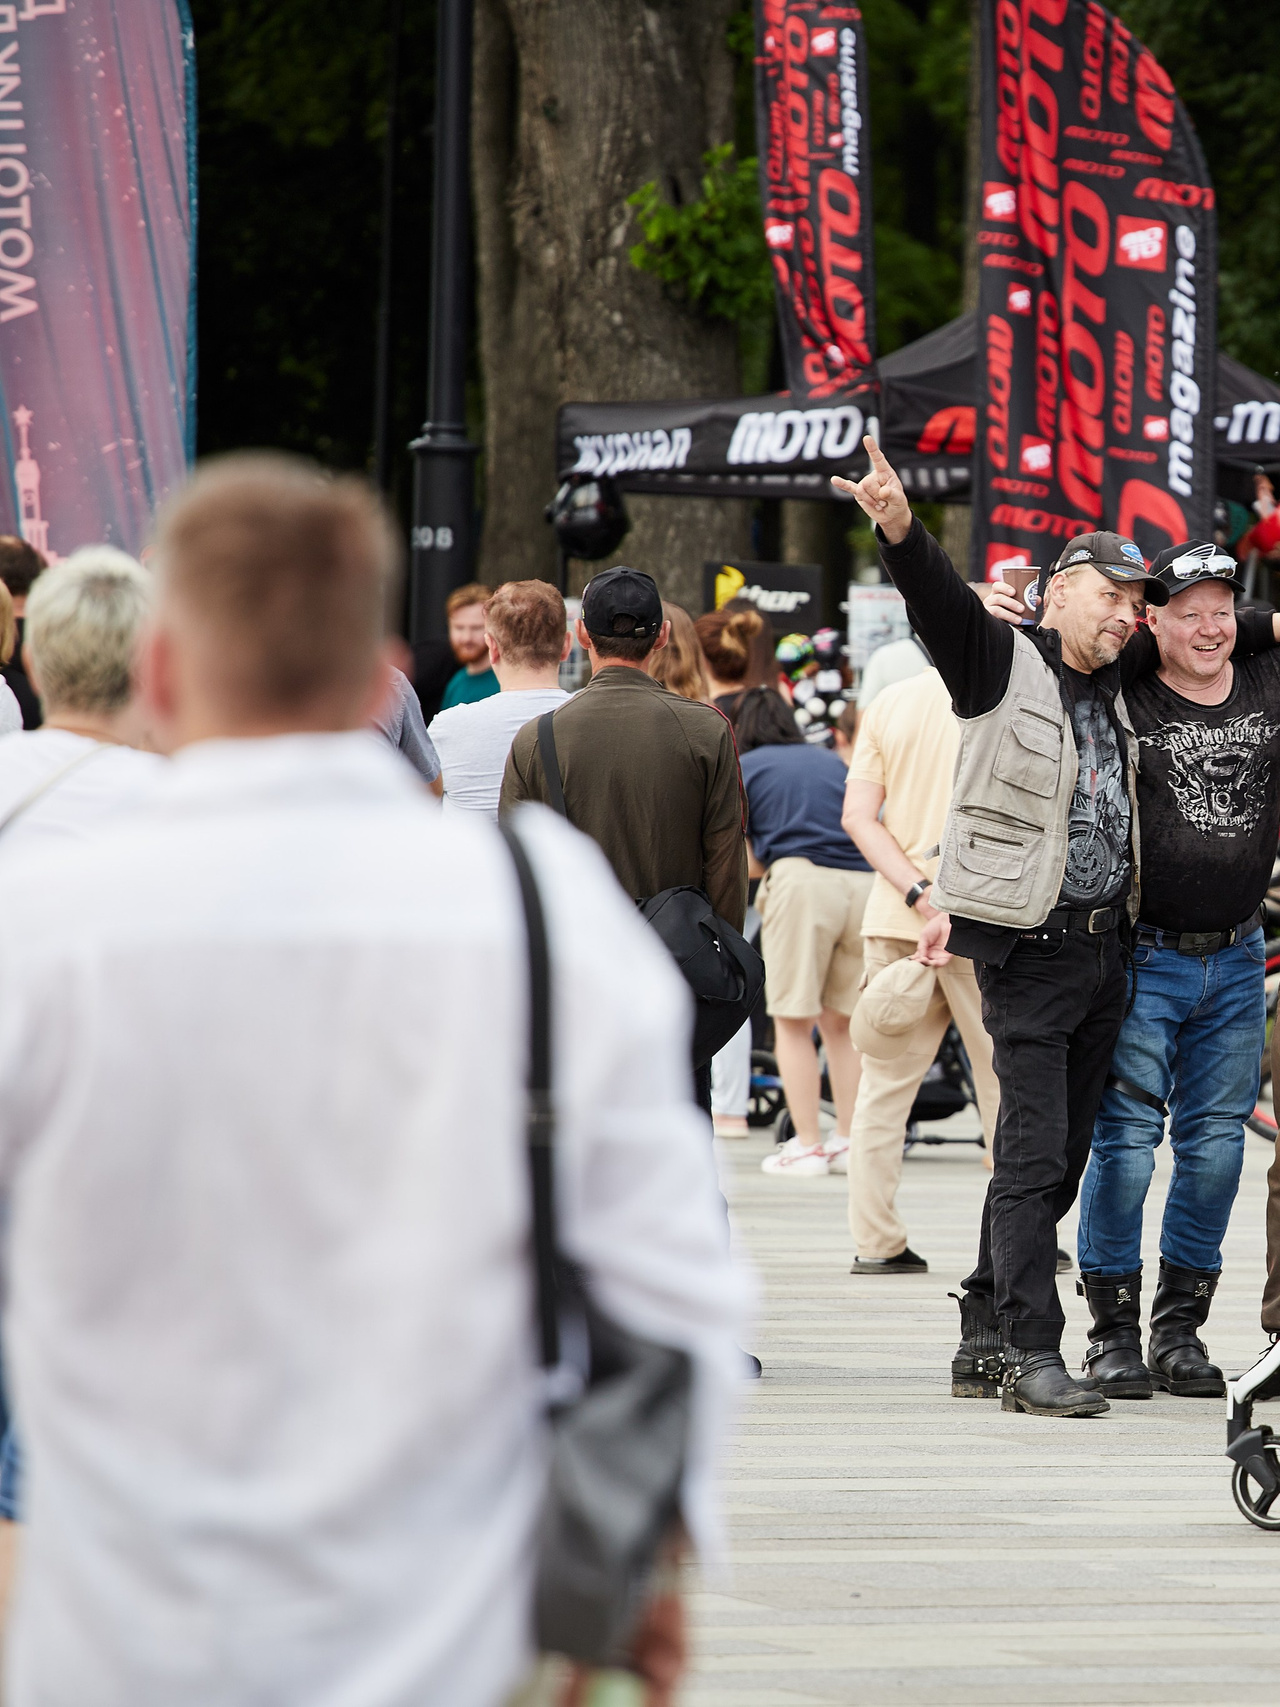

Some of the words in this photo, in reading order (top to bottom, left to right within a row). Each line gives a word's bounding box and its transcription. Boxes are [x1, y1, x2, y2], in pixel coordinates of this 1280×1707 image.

[838, 27, 862, 177] magazine
[1018, 0, 1068, 259] MOT
[1063, 125, 1131, 147] MOTO
[977, 231, 1019, 248] OTO
[1134, 177, 1215, 211] MOT
[986, 313, 1014, 471] MOTO
[1058, 180, 1111, 519] MOTO
[1168, 225, 1201, 497] magazine
[573, 428, 692, 476] журнал
